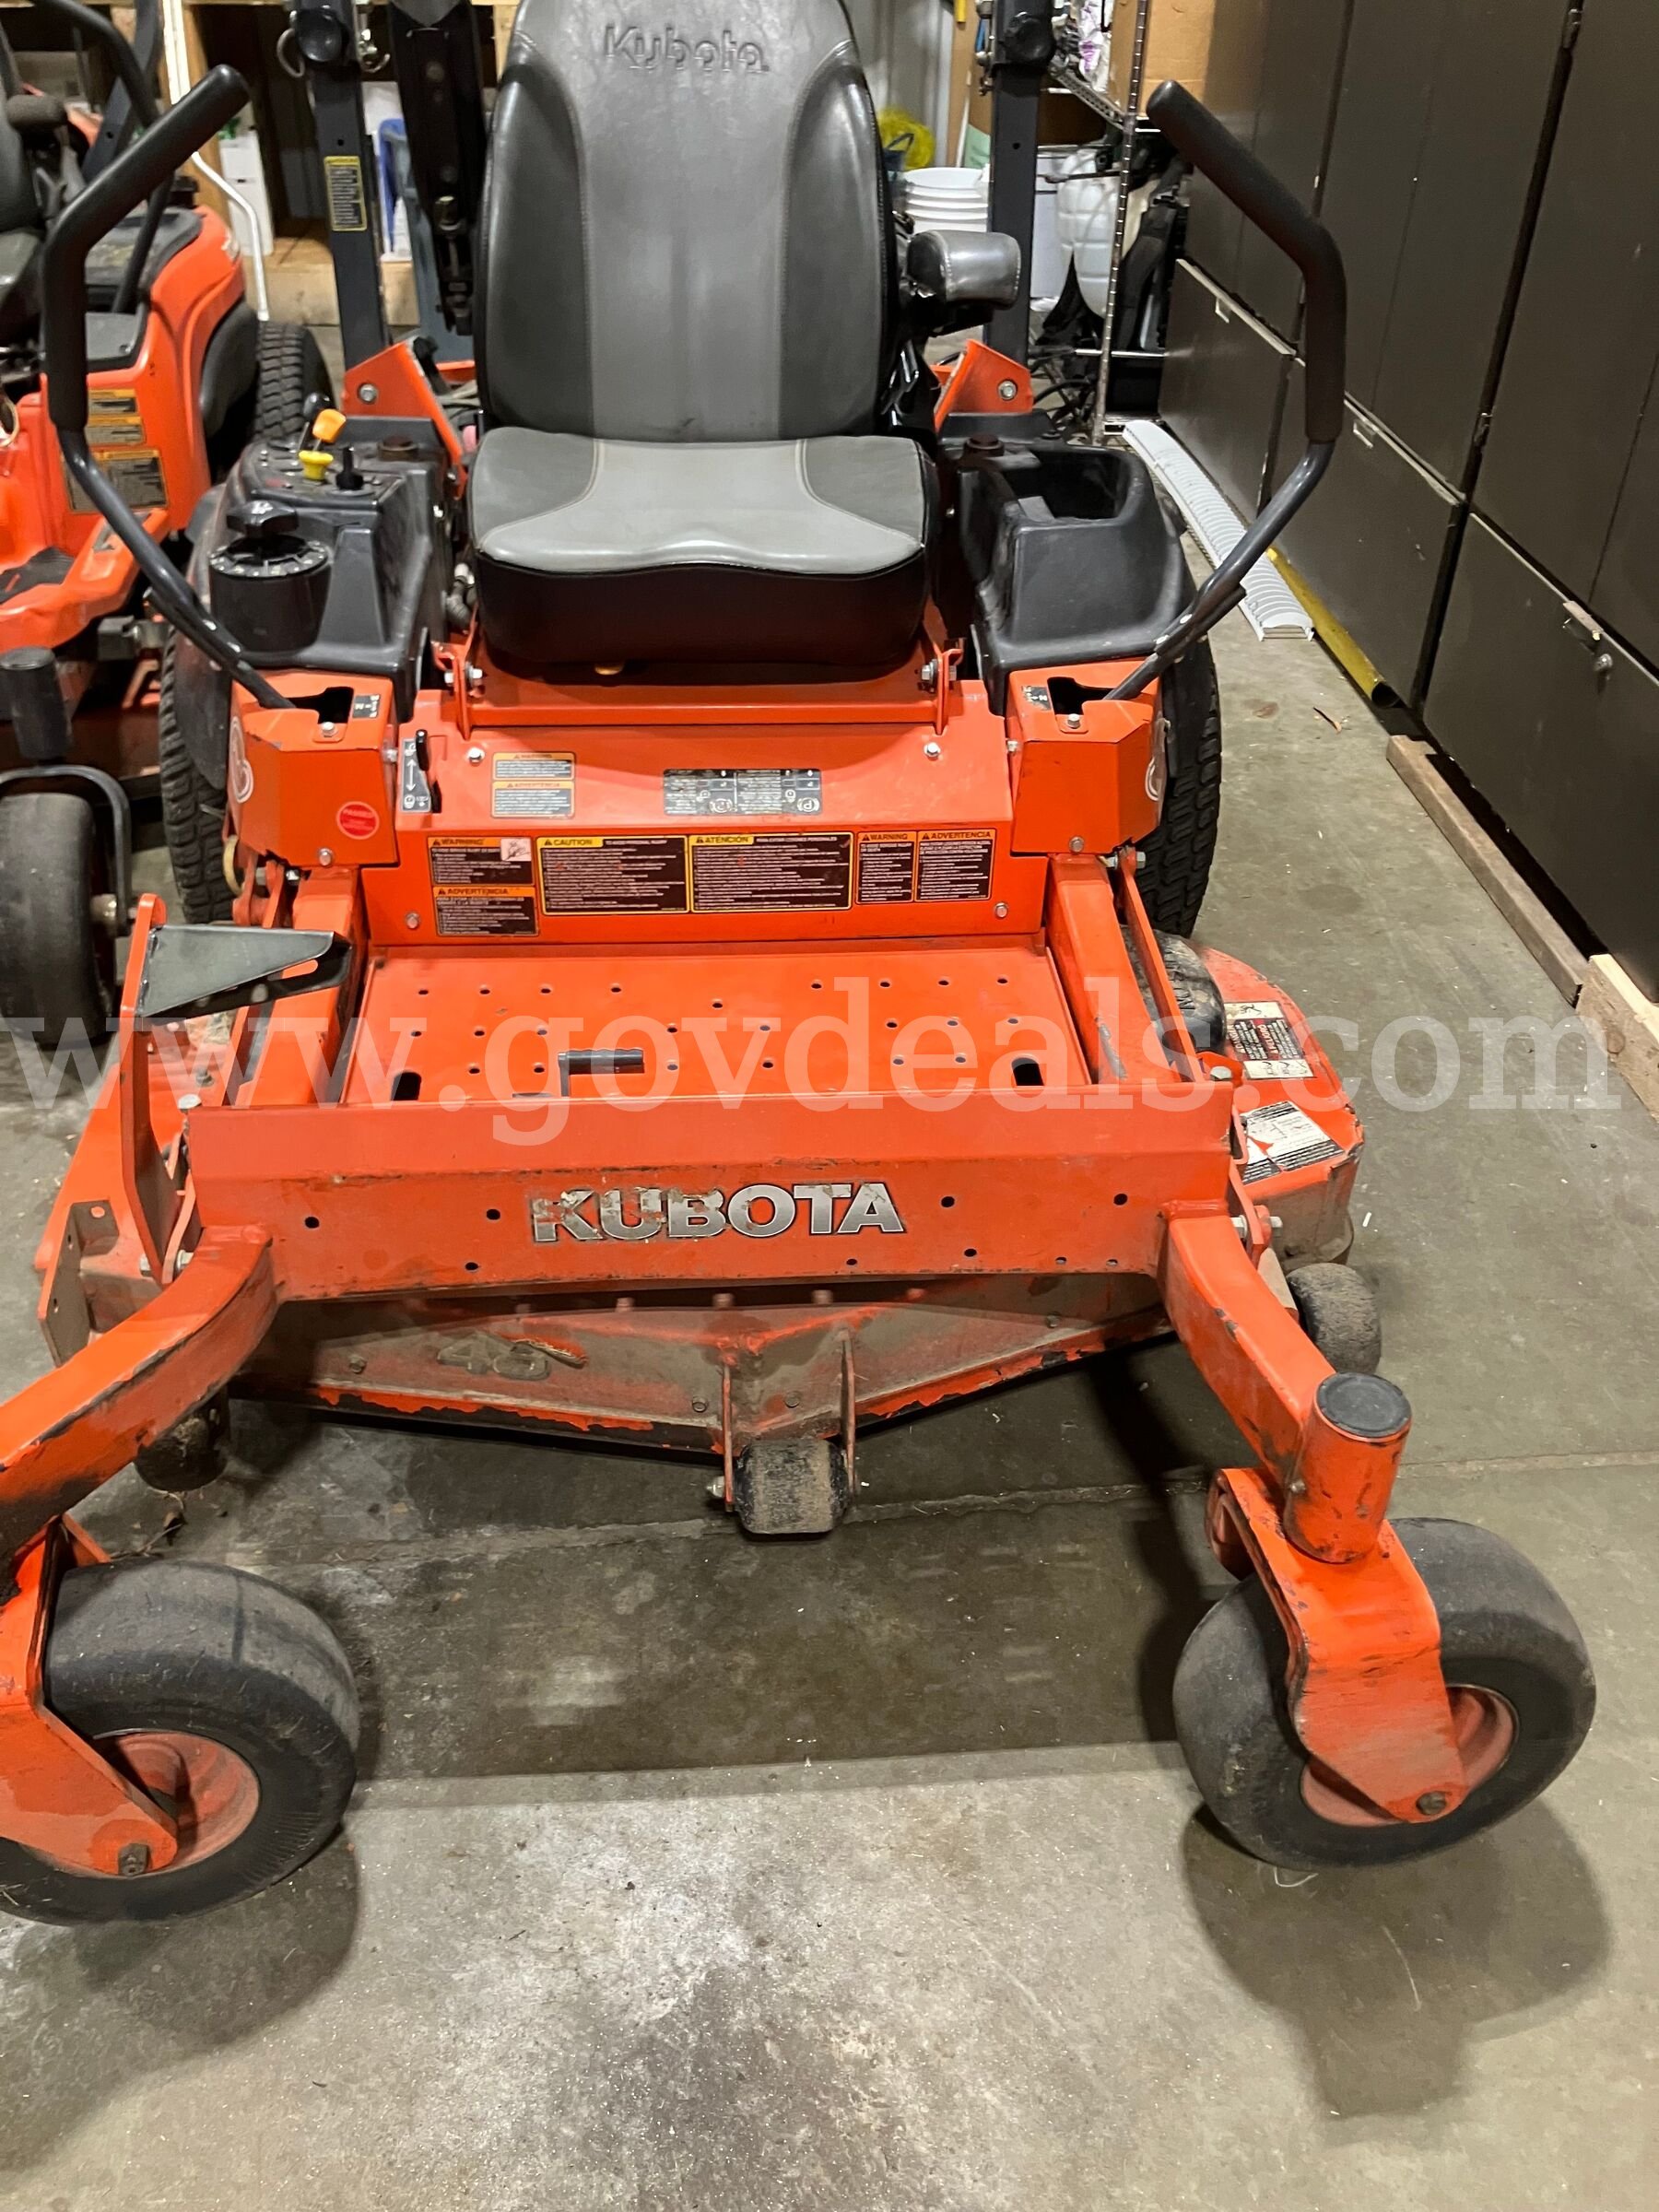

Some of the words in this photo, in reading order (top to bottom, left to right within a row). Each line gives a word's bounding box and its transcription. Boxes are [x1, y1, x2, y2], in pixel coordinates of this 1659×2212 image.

[605, 26, 770, 74] Kubota
[931, 831, 991, 840] ADVERTENCIA
[532, 1182, 908, 1243] KUBOTA
